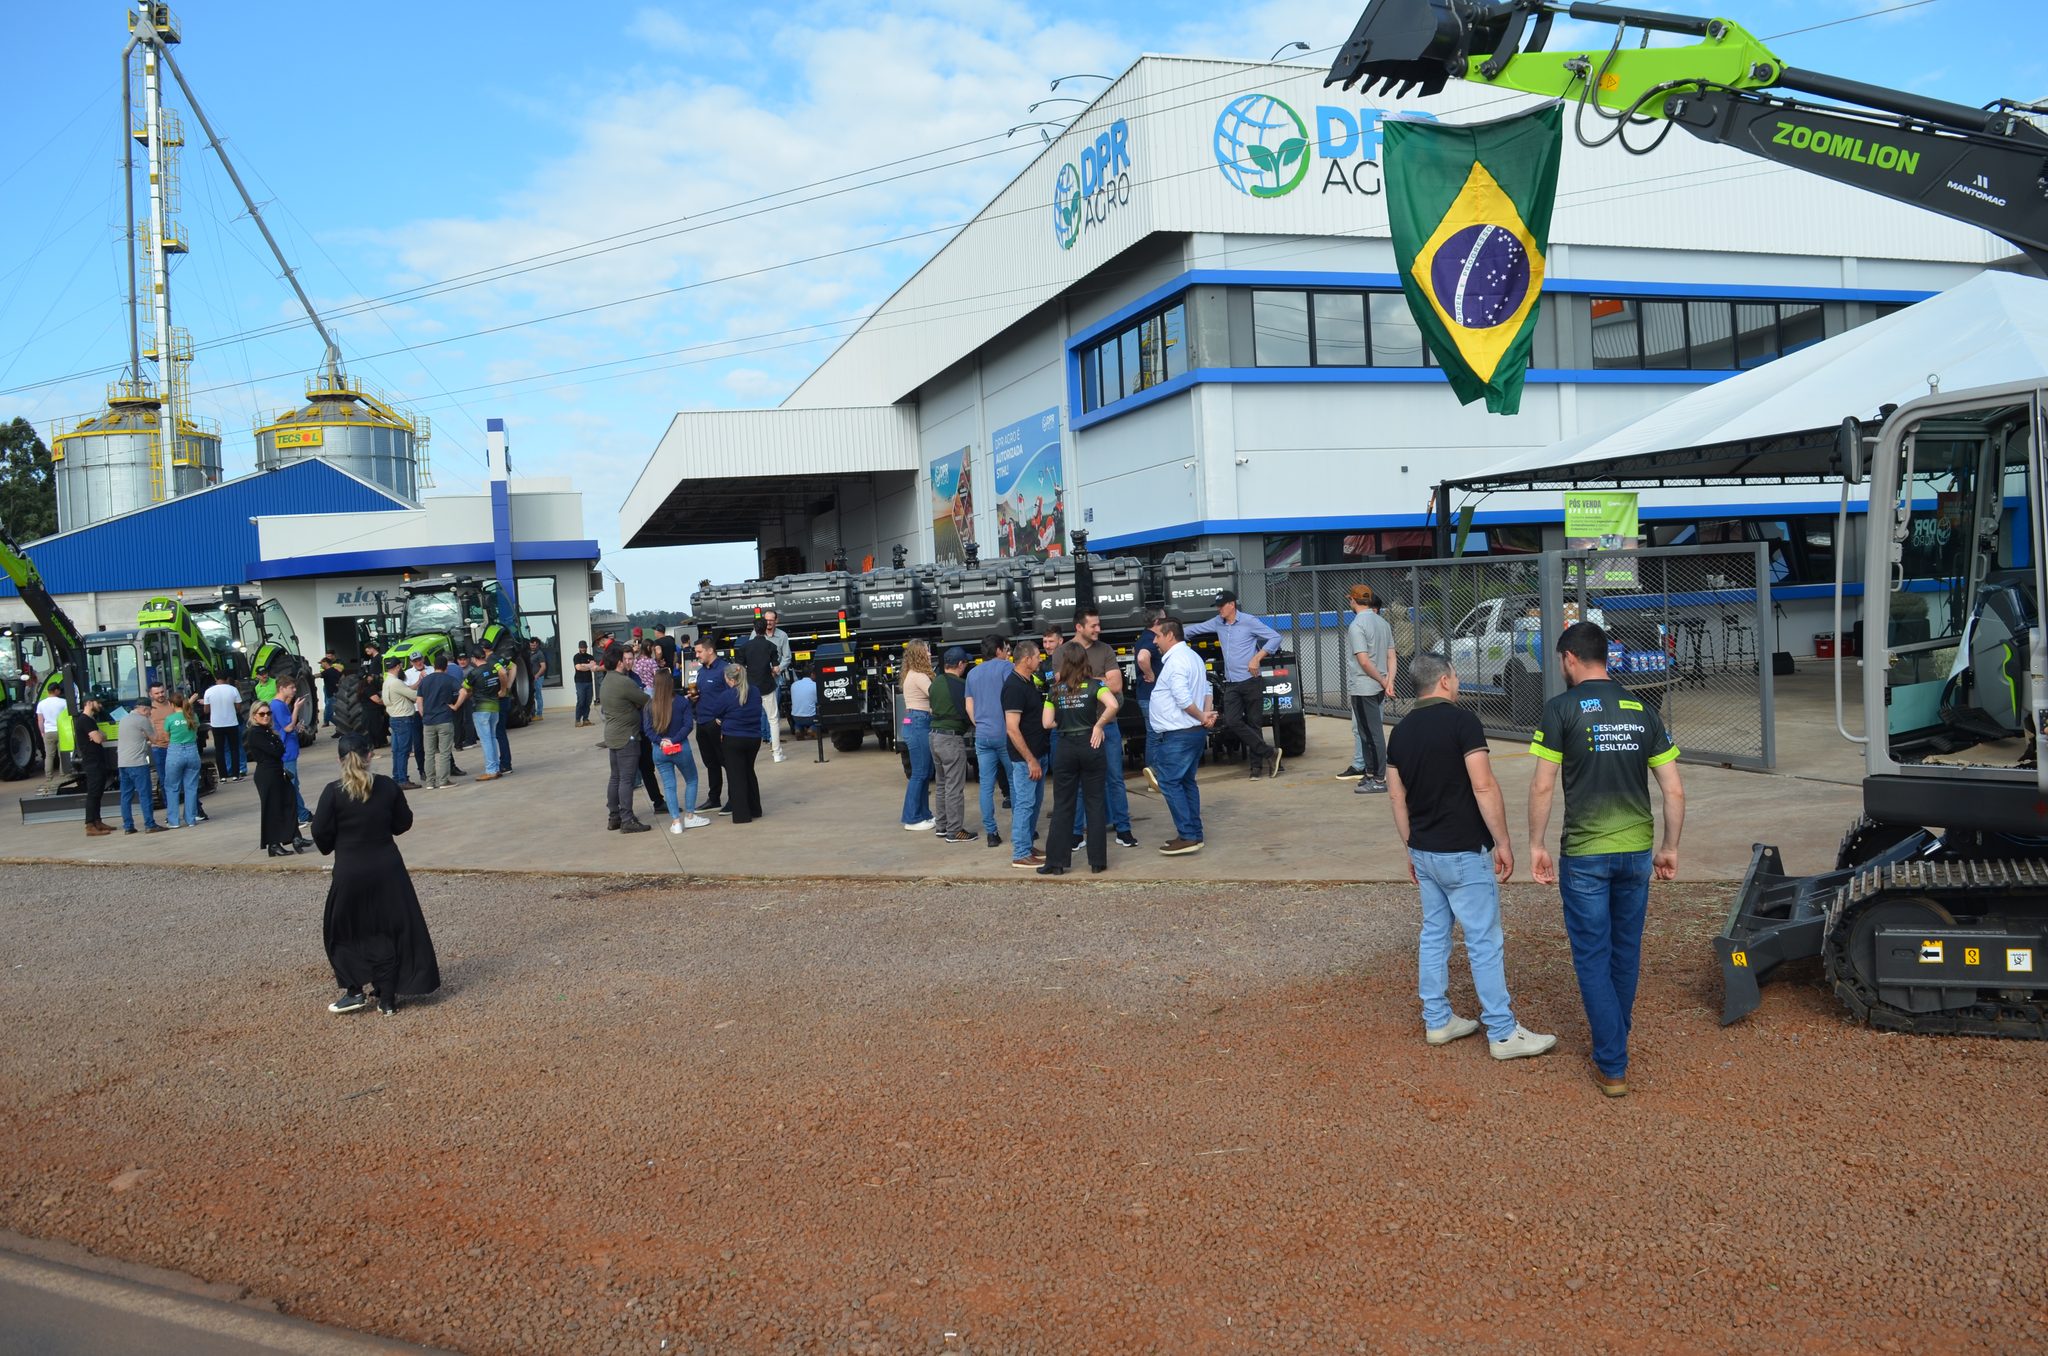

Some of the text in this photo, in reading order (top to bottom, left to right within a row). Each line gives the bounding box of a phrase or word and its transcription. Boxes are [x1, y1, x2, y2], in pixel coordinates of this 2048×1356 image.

[1772, 121, 1921, 175] ZOOMLION
[1081, 117, 1131, 200] DPR
[1322, 159, 1381, 195] AG
[1947, 180, 2007, 207] MANTOMAC
[1085, 172, 1130, 234] AGRO
[1463, 226, 1493, 277] PROGRESSO
[1582, 500, 1602, 508] VENDA
[869, 593, 904, 602] PLANTIO
[1055, 593, 1134, 606] HID PLUS
[872, 601, 903, 609] DIRETO
[953, 599, 996, 611] PLANTIO
[957, 609, 994, 619] DIRETO
[1580, 699, 1600, 709] DPR
[1583, 704, 1603, 713] AGRO
[1593, 723, 1645, 733] DESEMPENHO
[1595, 743, 1640, 752] RESULTADO
